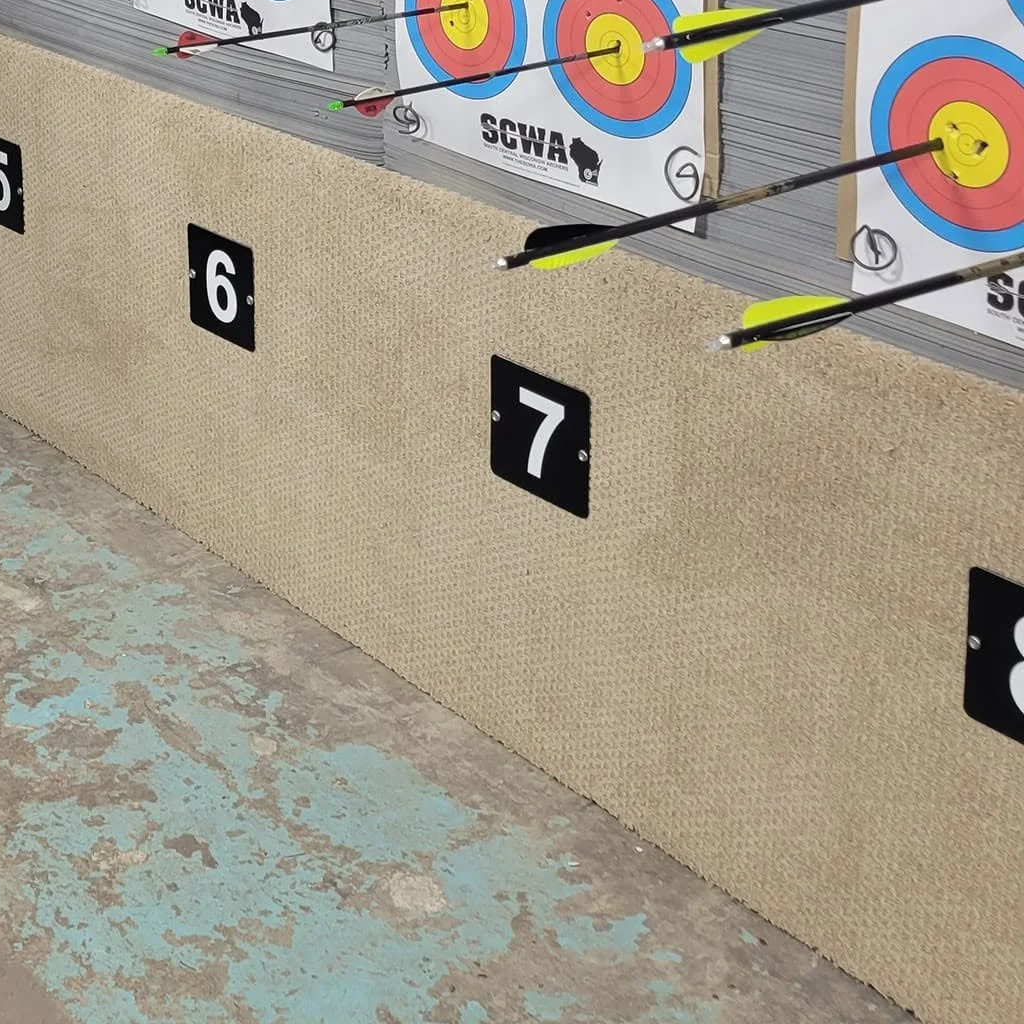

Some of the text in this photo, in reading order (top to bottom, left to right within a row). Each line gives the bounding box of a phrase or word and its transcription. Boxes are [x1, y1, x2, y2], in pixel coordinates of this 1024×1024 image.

[480, 113, 568, 165] SCWA
[206, 249, 237, 324] 6
[519, 386, 565, 479] 7
